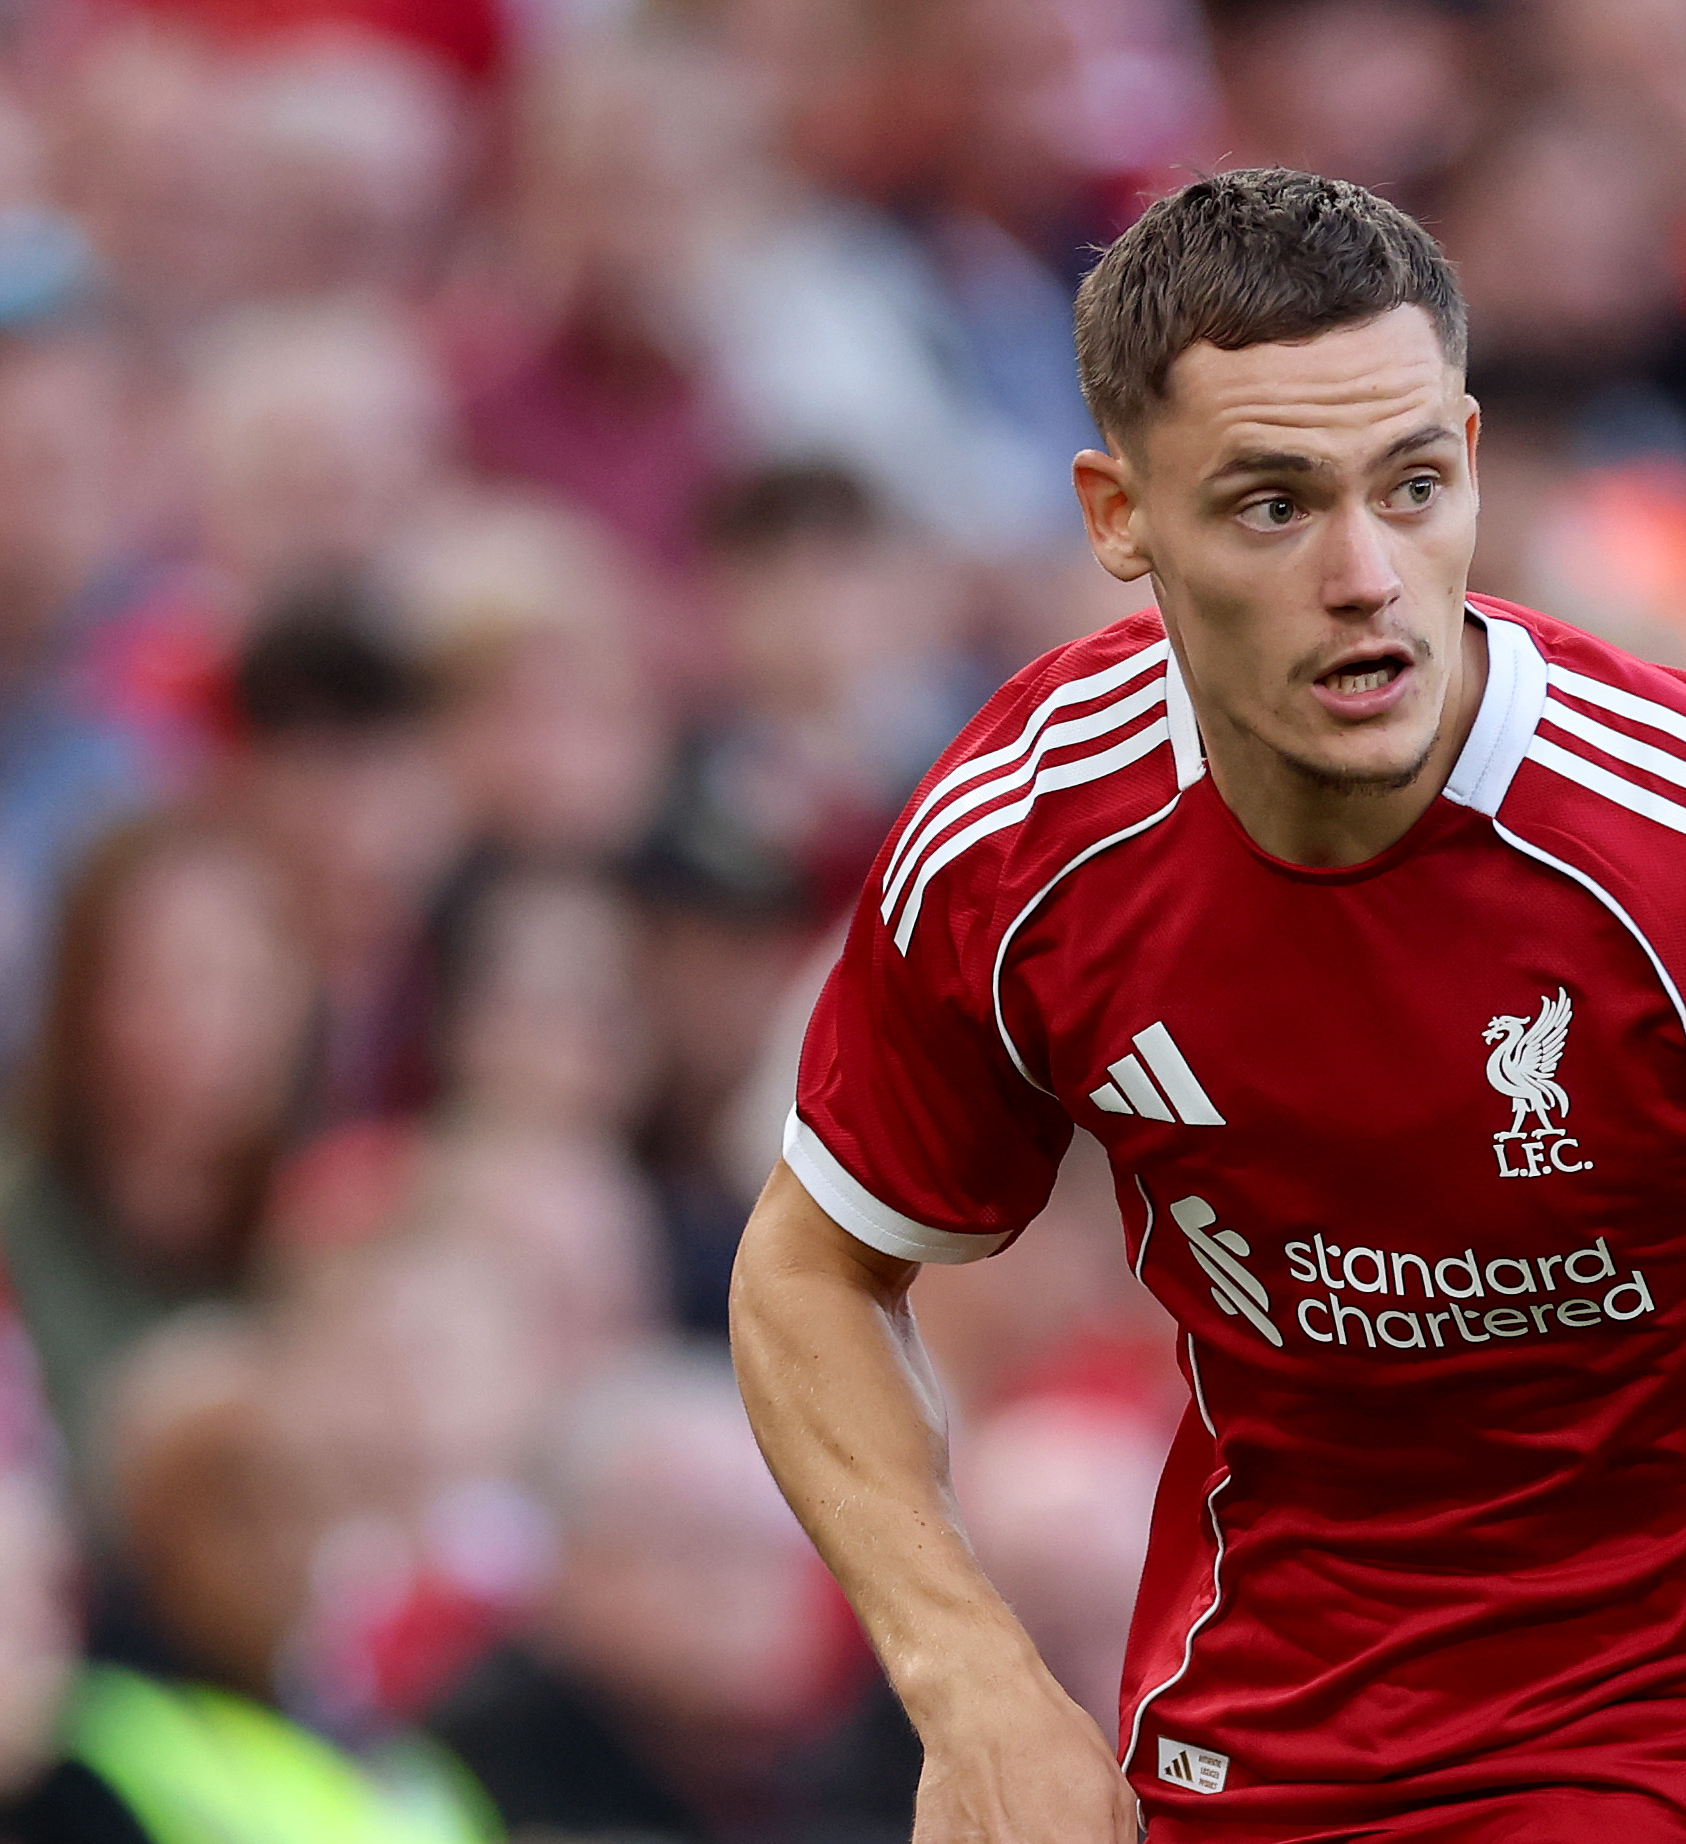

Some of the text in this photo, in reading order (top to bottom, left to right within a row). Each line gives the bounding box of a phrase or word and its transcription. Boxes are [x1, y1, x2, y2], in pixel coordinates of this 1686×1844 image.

[1493, 1139, 1594, 1178] L.F.C.
[1284, 1232, 1616, 1299] standard
[1297, 1270, 1655, 1349] chartered
